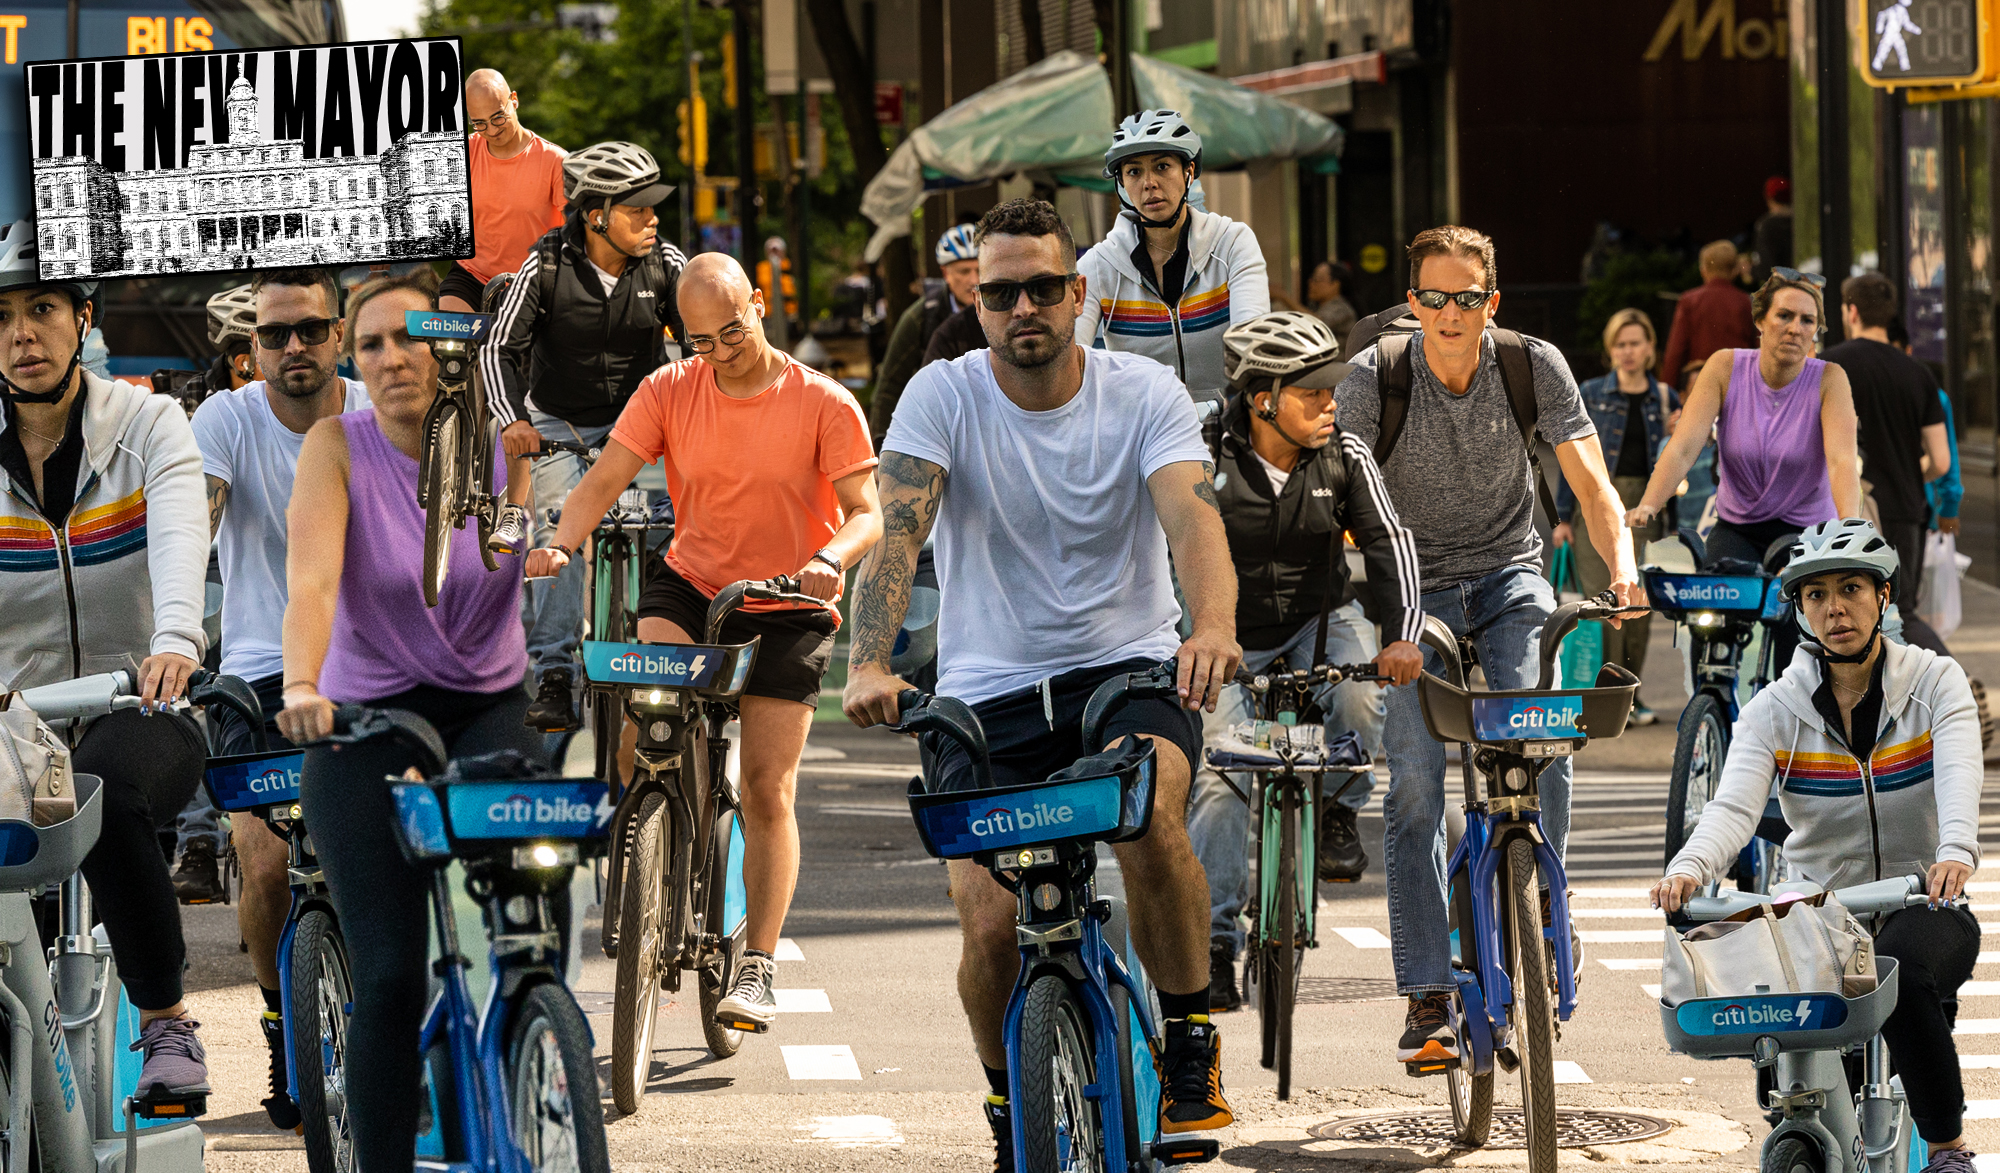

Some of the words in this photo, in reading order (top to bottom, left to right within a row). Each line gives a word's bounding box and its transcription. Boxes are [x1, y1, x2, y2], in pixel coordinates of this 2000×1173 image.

[127, 16, 214, 56] BUS
[422, 317, 442, 331] citi
[444, 319, 470, 332] bike
[610, 652, 643, 673] citi
[645, 656, 687, 675] bike
[1509, 706, 1545, 728] citi
[1546, 707, 1579, 727] bik
[250, 768, 286, 793] citi
[487, 794, 532, 823] citi
[535, 797, 592, 823] bike
[971, 807, 1014, 836] citi
[1015, 803, 1074, 829] bike
[1712, 1004, 1746, 1026] citi
[1748, 1004, 1793, 1024] bike
[44, 1000, 63, 1053] citi
[55, 1036, 76, 1113] bike
